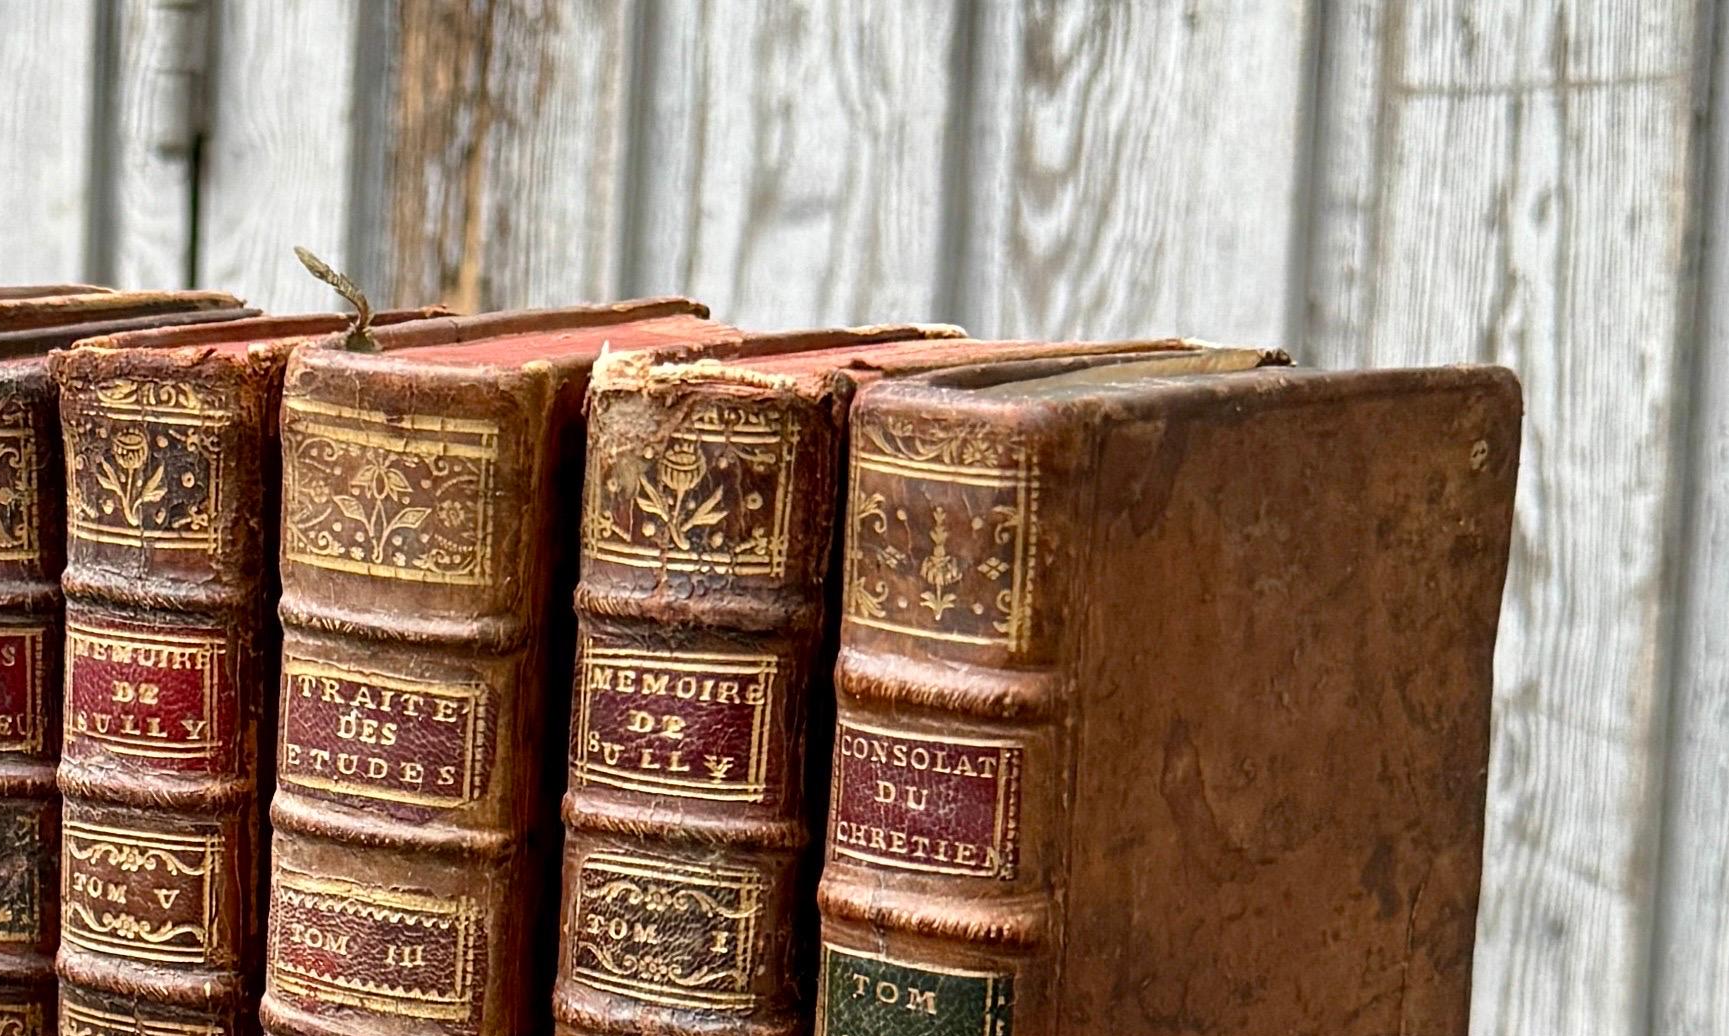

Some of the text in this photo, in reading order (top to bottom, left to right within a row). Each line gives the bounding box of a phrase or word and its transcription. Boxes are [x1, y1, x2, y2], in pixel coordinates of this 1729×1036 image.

[111, 680, 159, 705] DE
[76, 710, 207, 740] SULLY
[336, 712, 398, 746] DES
[626, 709, 687, 740] DE
[285, 743, 456, 786] ETUDES
[588, 731, 735, 780] SULLY
[841, 734, 998, 779] CONSOLAT
[874, 780, 929, 811] DU
[836, 820, 1002, 868] CHRETIEN
[73, 871, 180, 909] TOM V
[290, 923, 424, 968] TOM III
[586, 912, 729, 954] TOM I
[851, 973, 939, 1016] TOM
